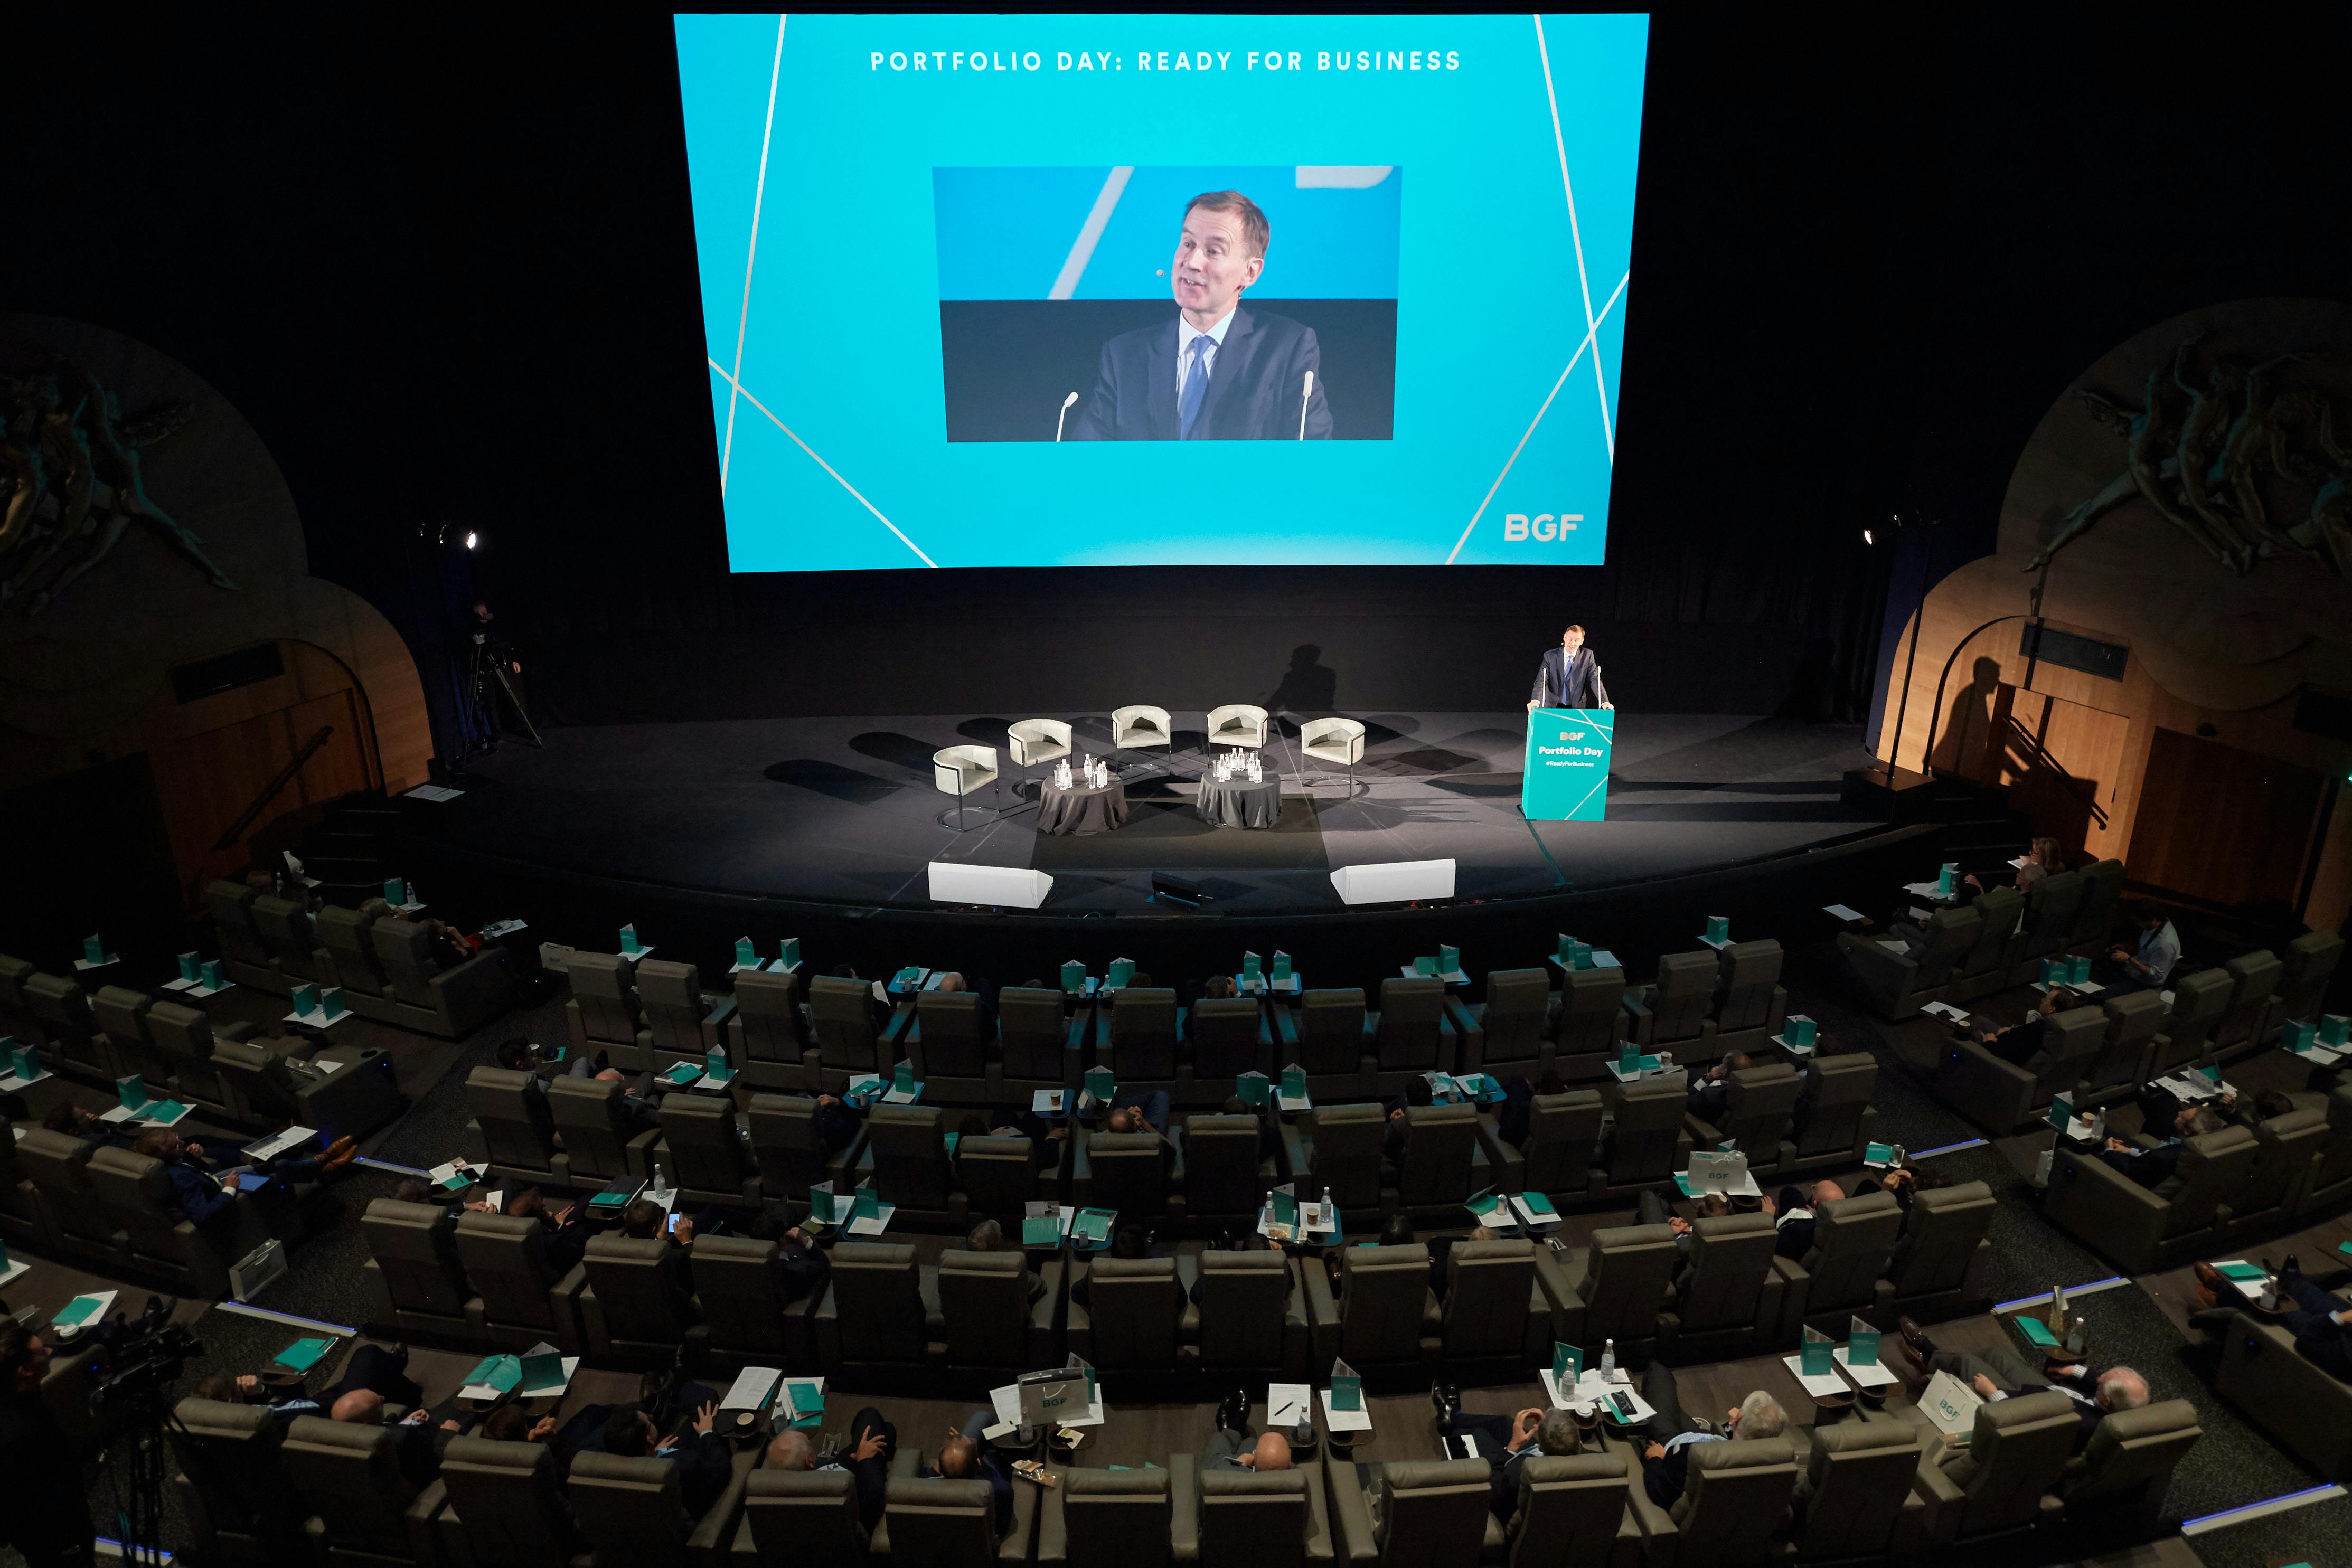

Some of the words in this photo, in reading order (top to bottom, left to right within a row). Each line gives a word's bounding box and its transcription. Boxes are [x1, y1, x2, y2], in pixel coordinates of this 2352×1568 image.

[871, 51, 1041, 71] PORTFOLIO
[1057, 52, 1121, 71] DAY:
[1137, 51, 1231, 71] READY
[1247, 51, 1301, 71] FOR
[1317, 51, 1460, 70] BUSINESS
[1504, 514, 1584, 542] BGF
[1559, 732, 1585, 741] BGF
[1538, 745, 1582, 755] Portfolio
[1583, 747, 1603, 757] Day
[1043, 1398, 1067, 1408] BGF
[1940, 1399, 1960, 1418] BGF
